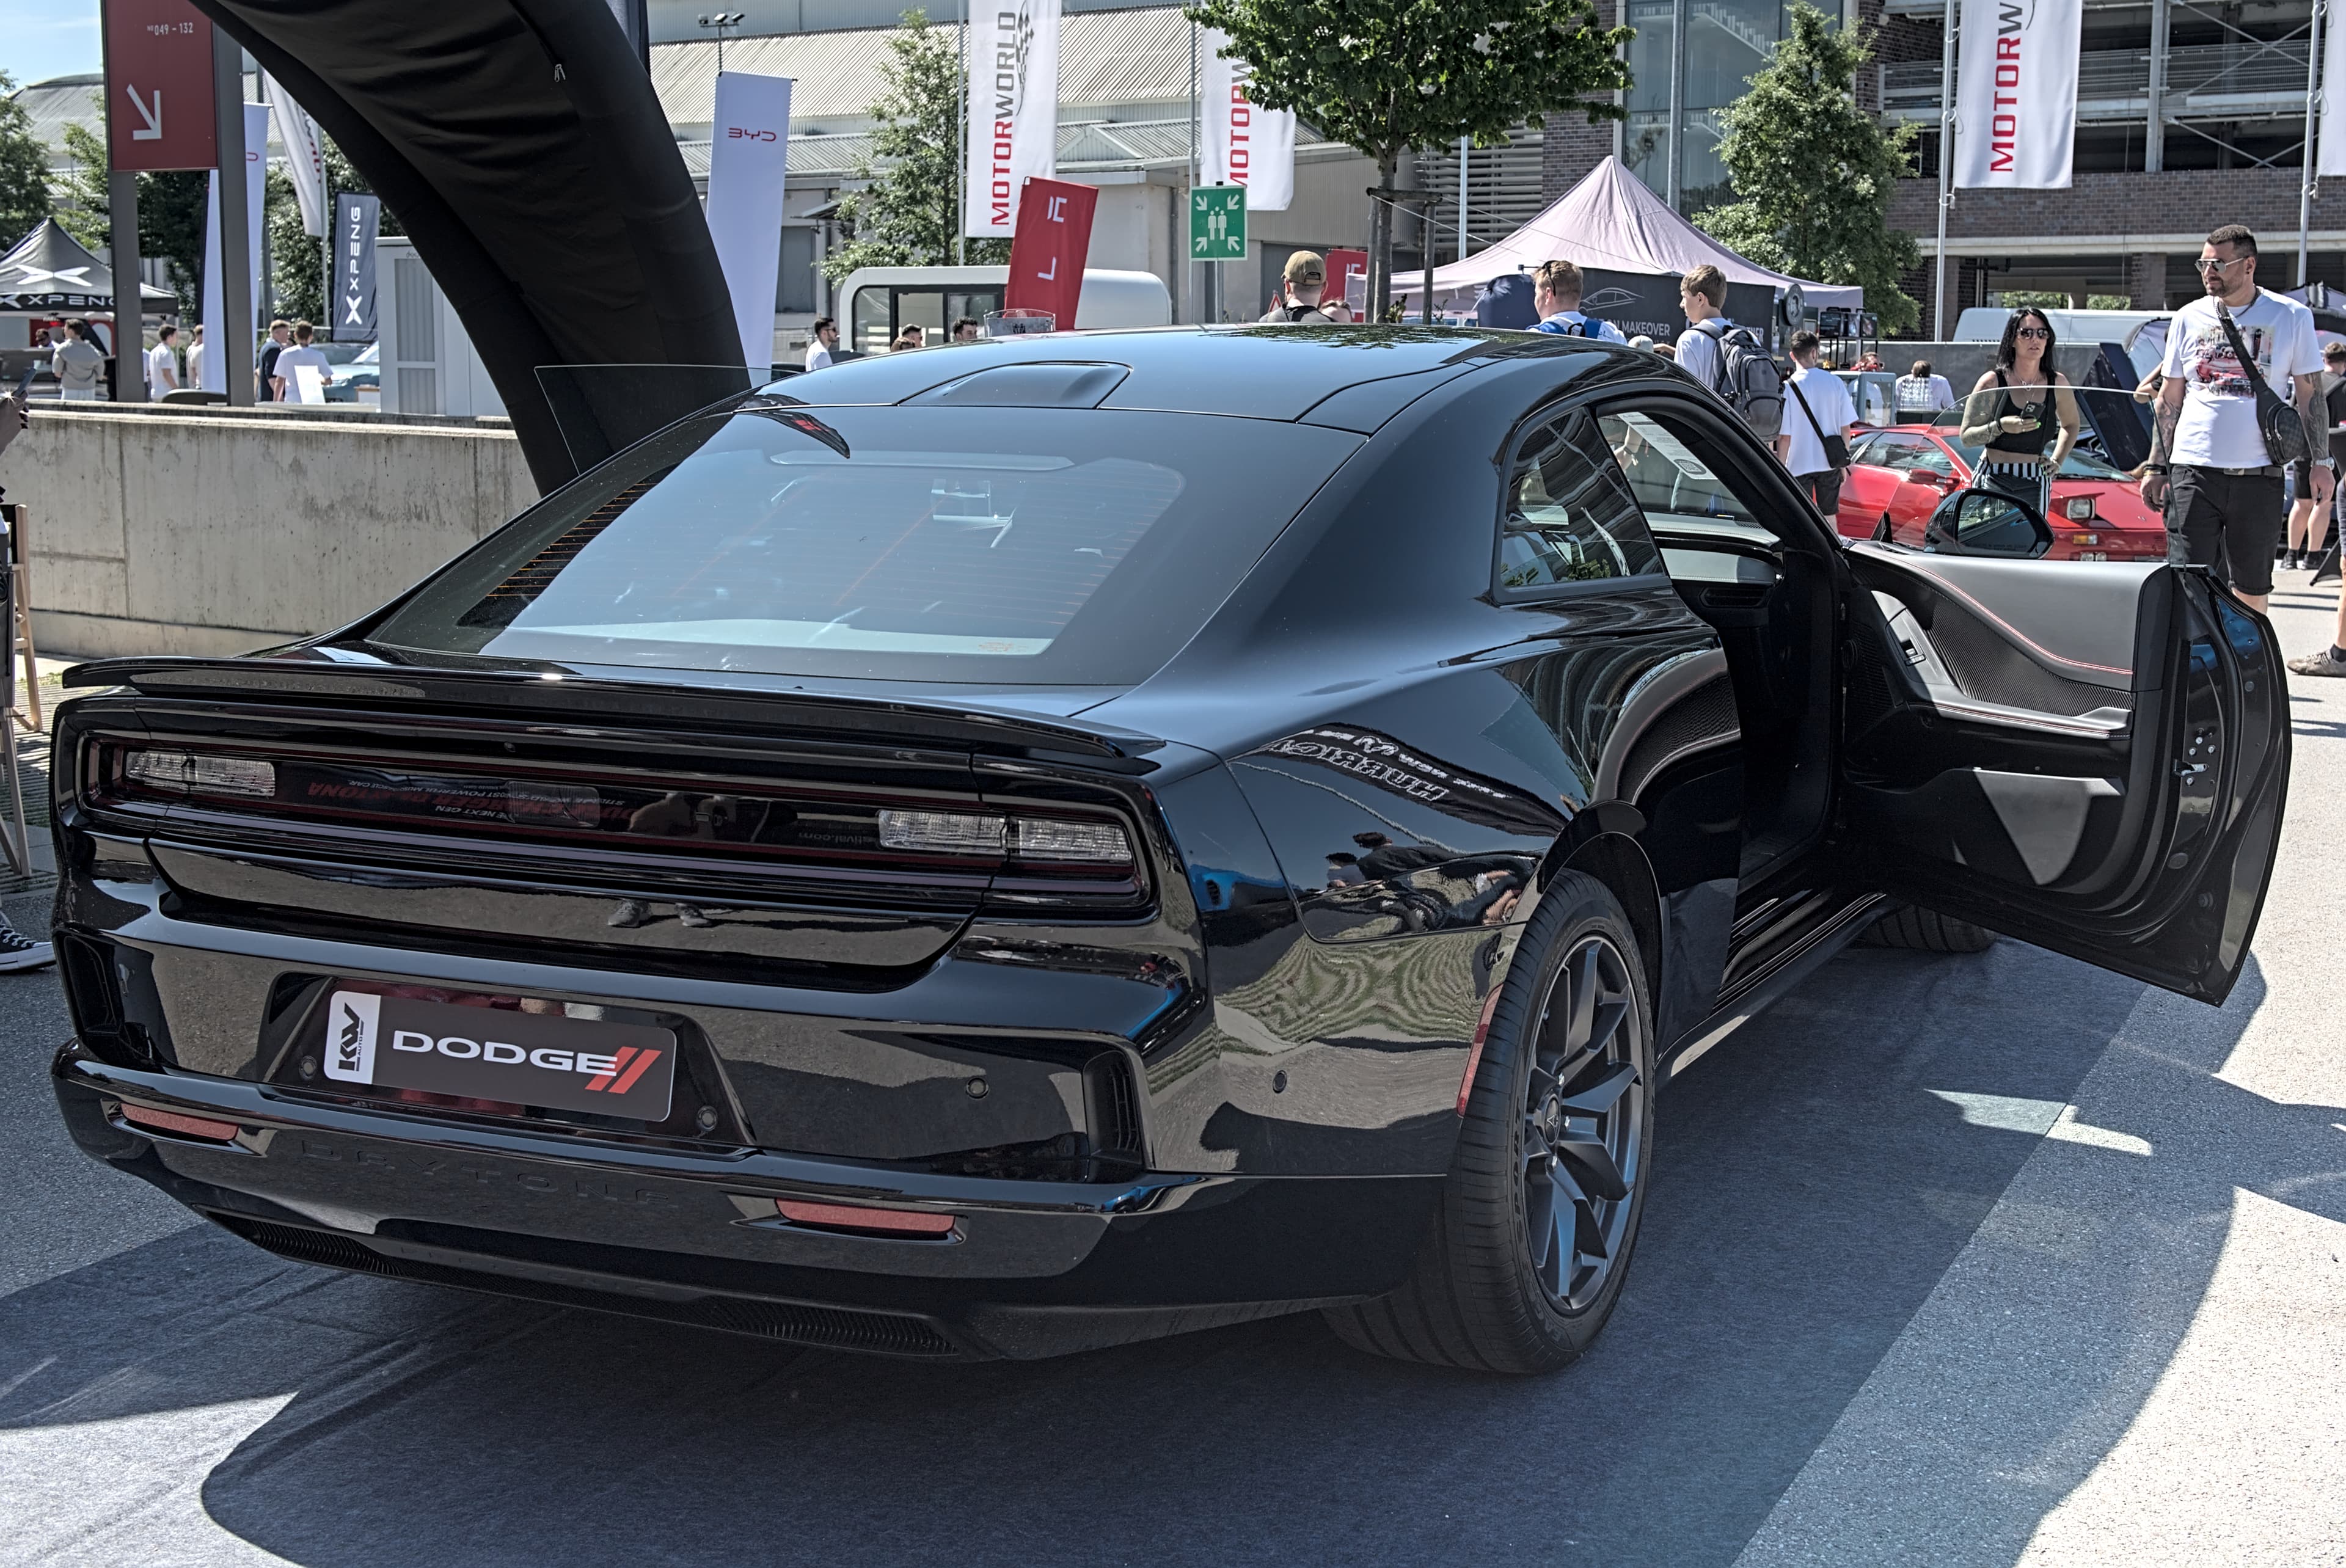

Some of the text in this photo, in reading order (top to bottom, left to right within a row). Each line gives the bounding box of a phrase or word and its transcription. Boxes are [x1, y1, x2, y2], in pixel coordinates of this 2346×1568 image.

[179, 22, 194, 34] 132
[728, 127, 777, 142] BYD
[991, 11, 1017, 225] MOTORWORLD
[349, 206, 361, 291] XPENG
[1622, 319, 1671, 337] MAKEOVER
[392, 1029, 618, 1078] DODGE
